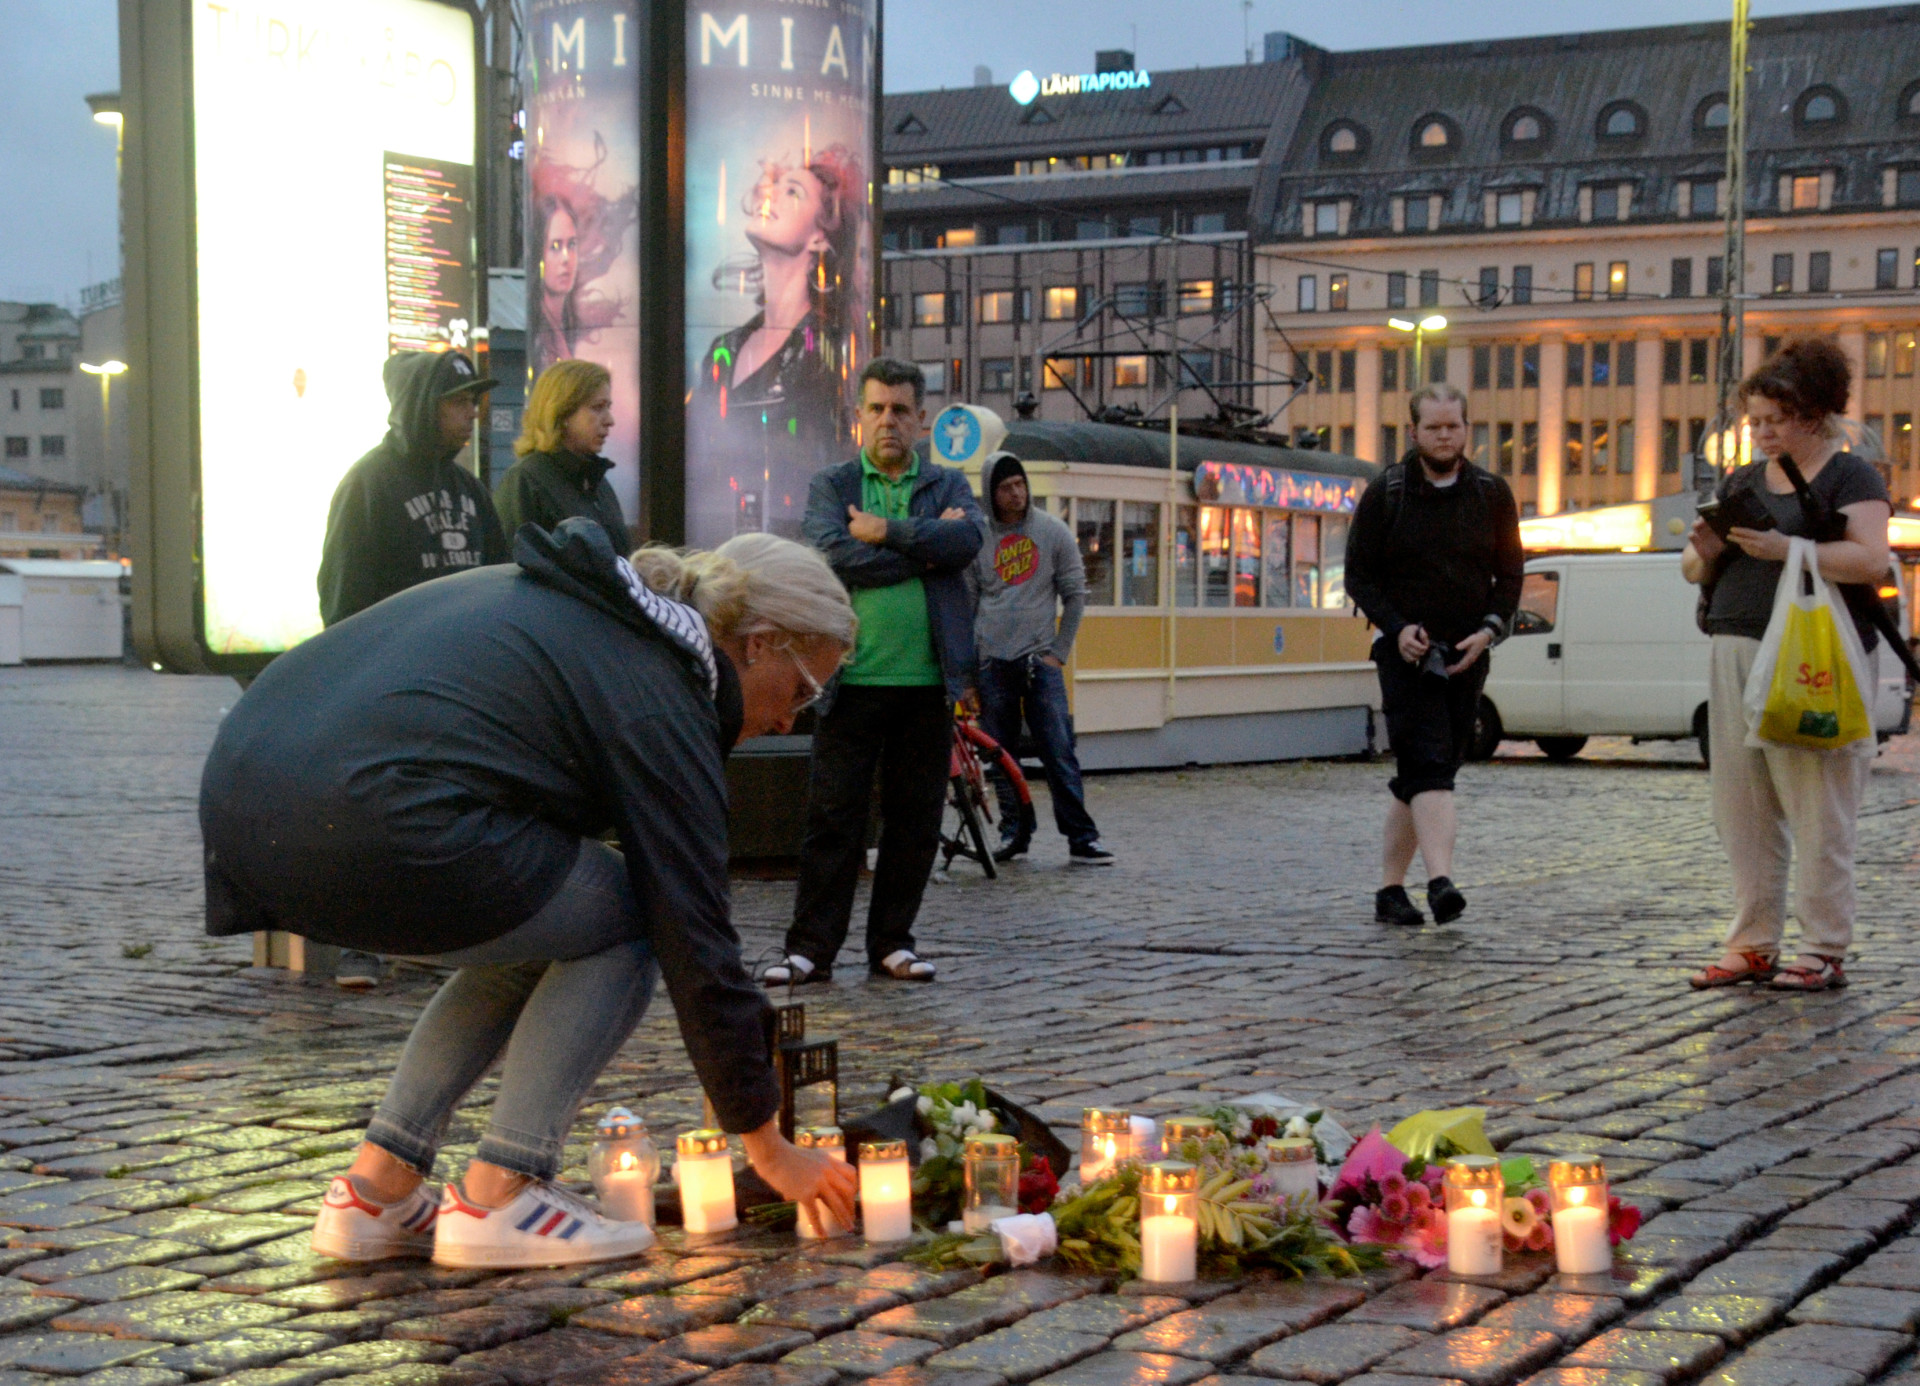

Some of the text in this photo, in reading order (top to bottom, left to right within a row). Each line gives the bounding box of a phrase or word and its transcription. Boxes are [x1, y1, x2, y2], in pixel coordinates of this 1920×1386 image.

[751, 82, 805, 101] SINNE
[814, 90, 832, 105] ME
[1041, 69, 1151, 97] LÄHITAPIOLA
[994, 538, 1034, 569] SANTA
[1002, 554, 1033, 582] CRUZ
